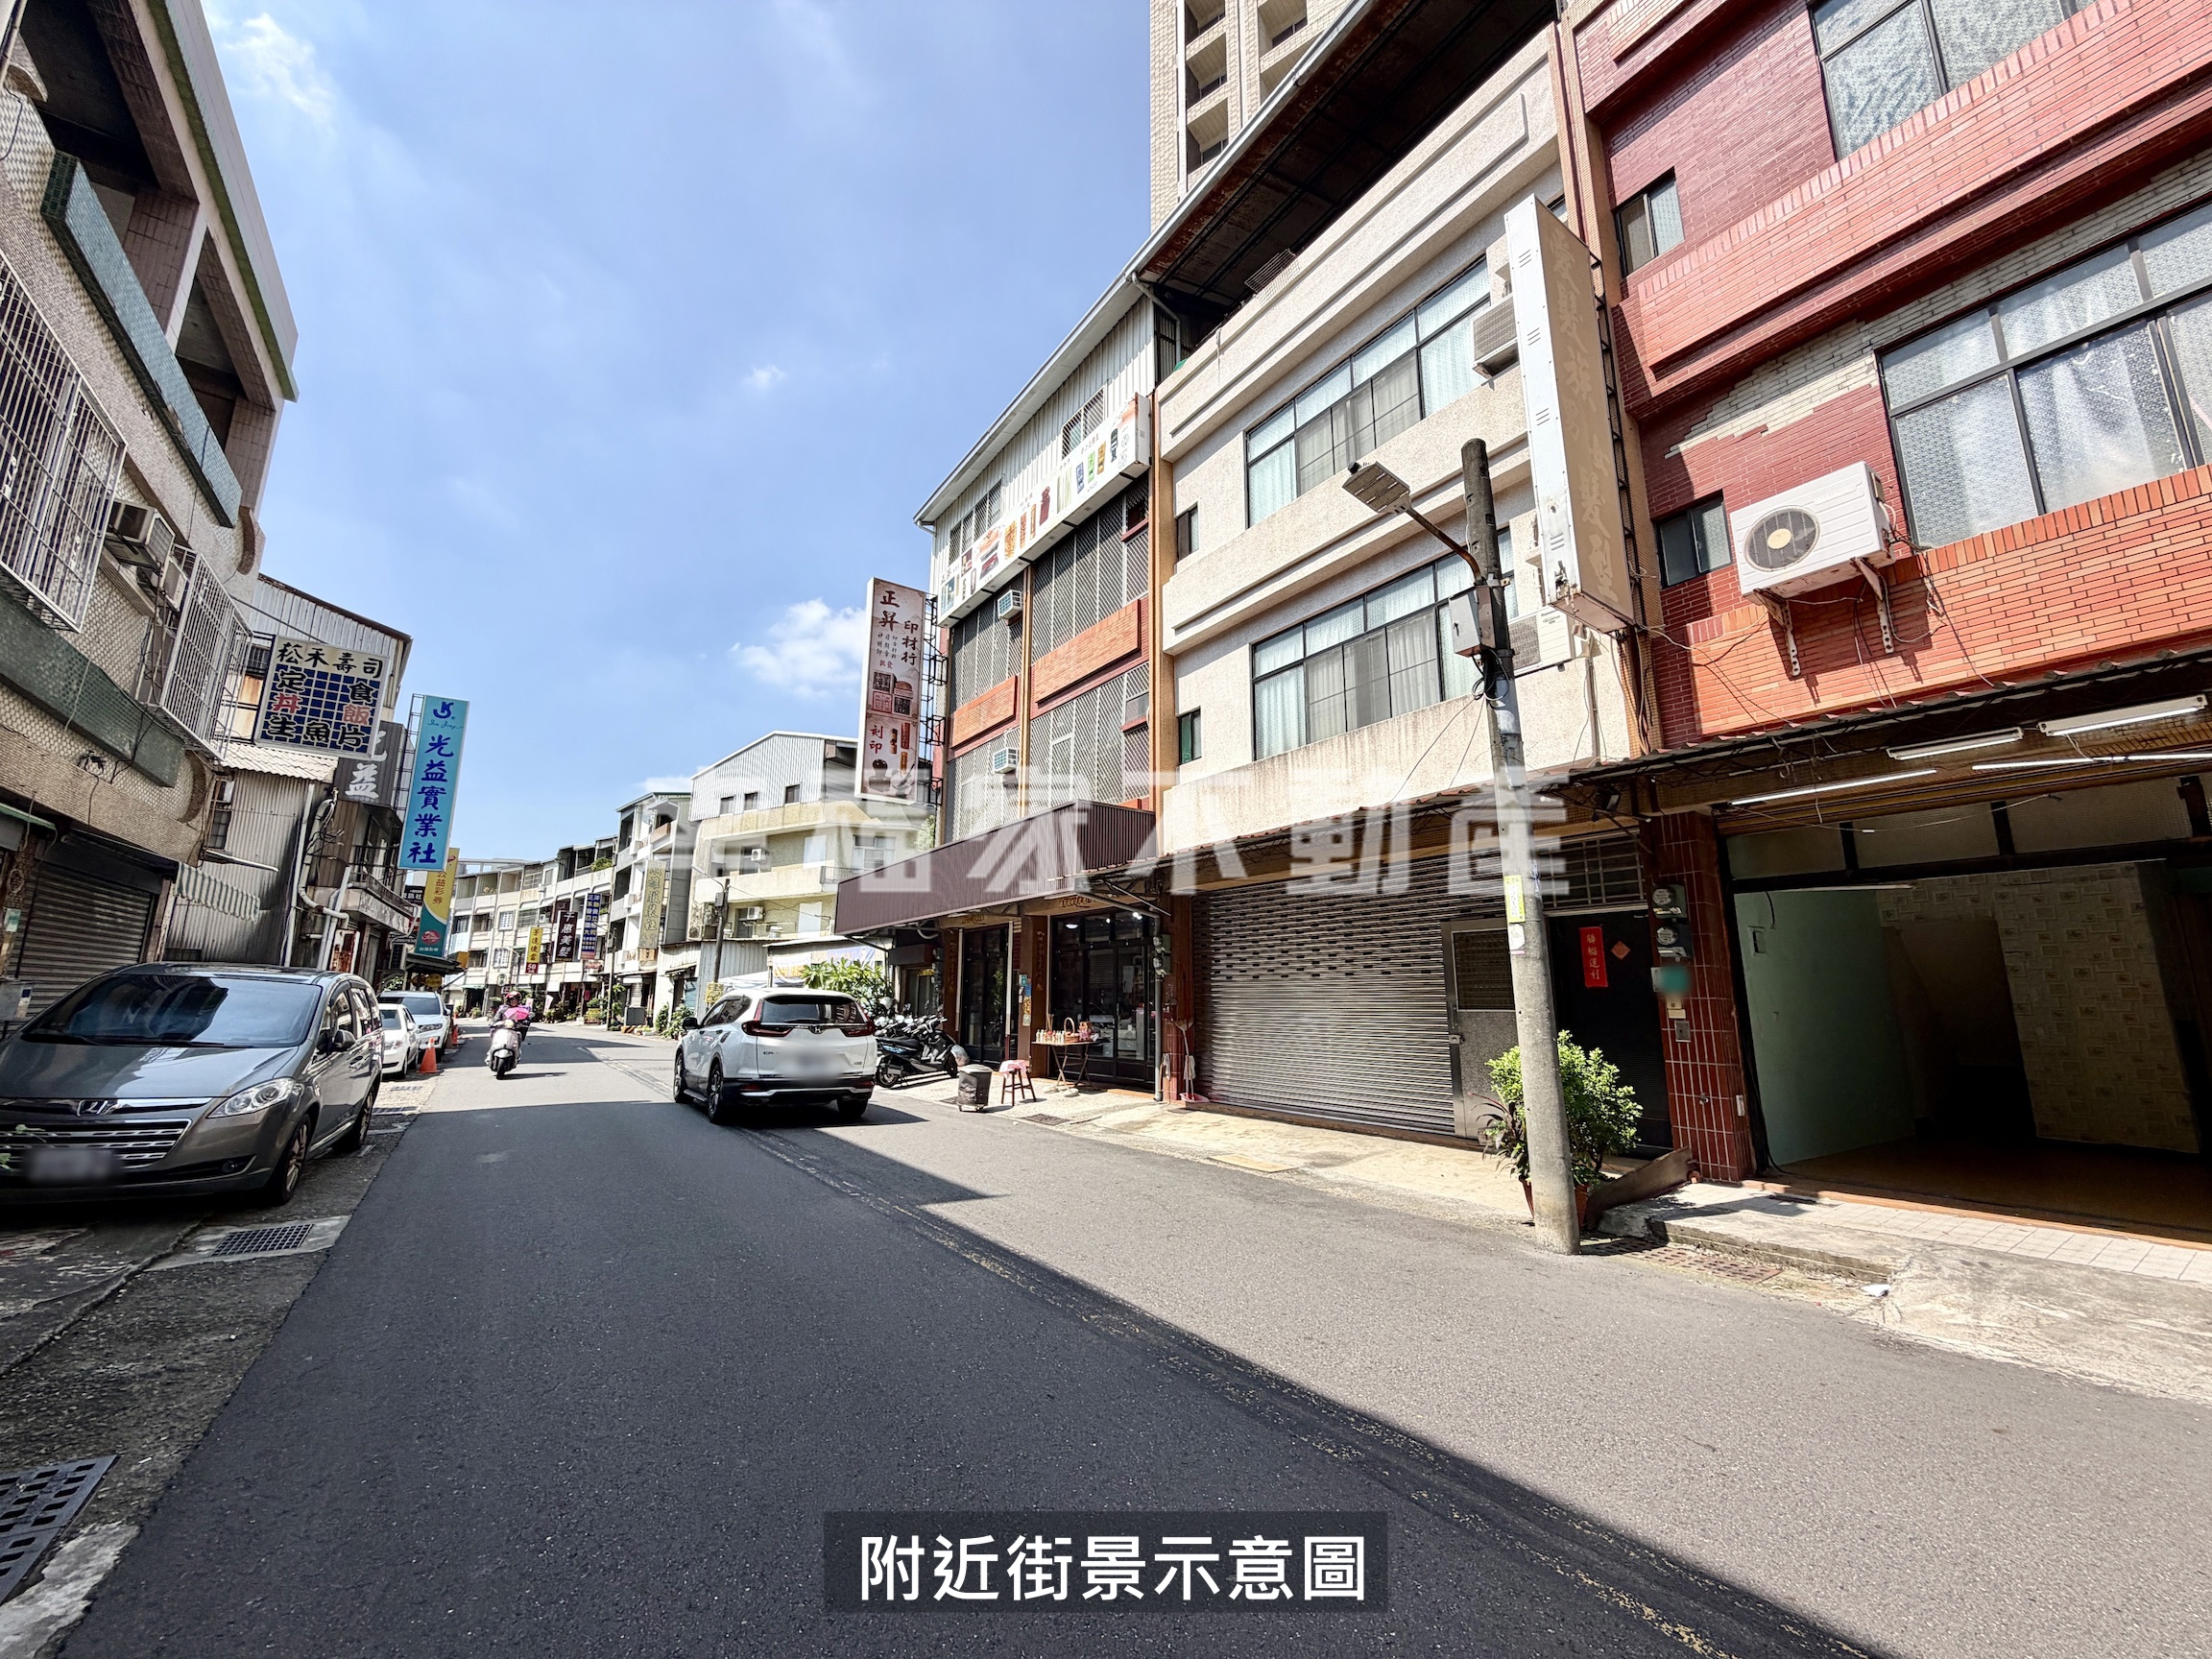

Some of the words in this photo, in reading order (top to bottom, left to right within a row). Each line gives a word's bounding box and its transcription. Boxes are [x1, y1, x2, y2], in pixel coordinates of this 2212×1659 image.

[878, 590, 901, 632] 正昇
[902, 620, 919, 665] 印材行
[268, 716, 367, 747] 生魚片
[869, 725, 883, 755] 刻印
[407, 734, 455, 864] 光益實業社
